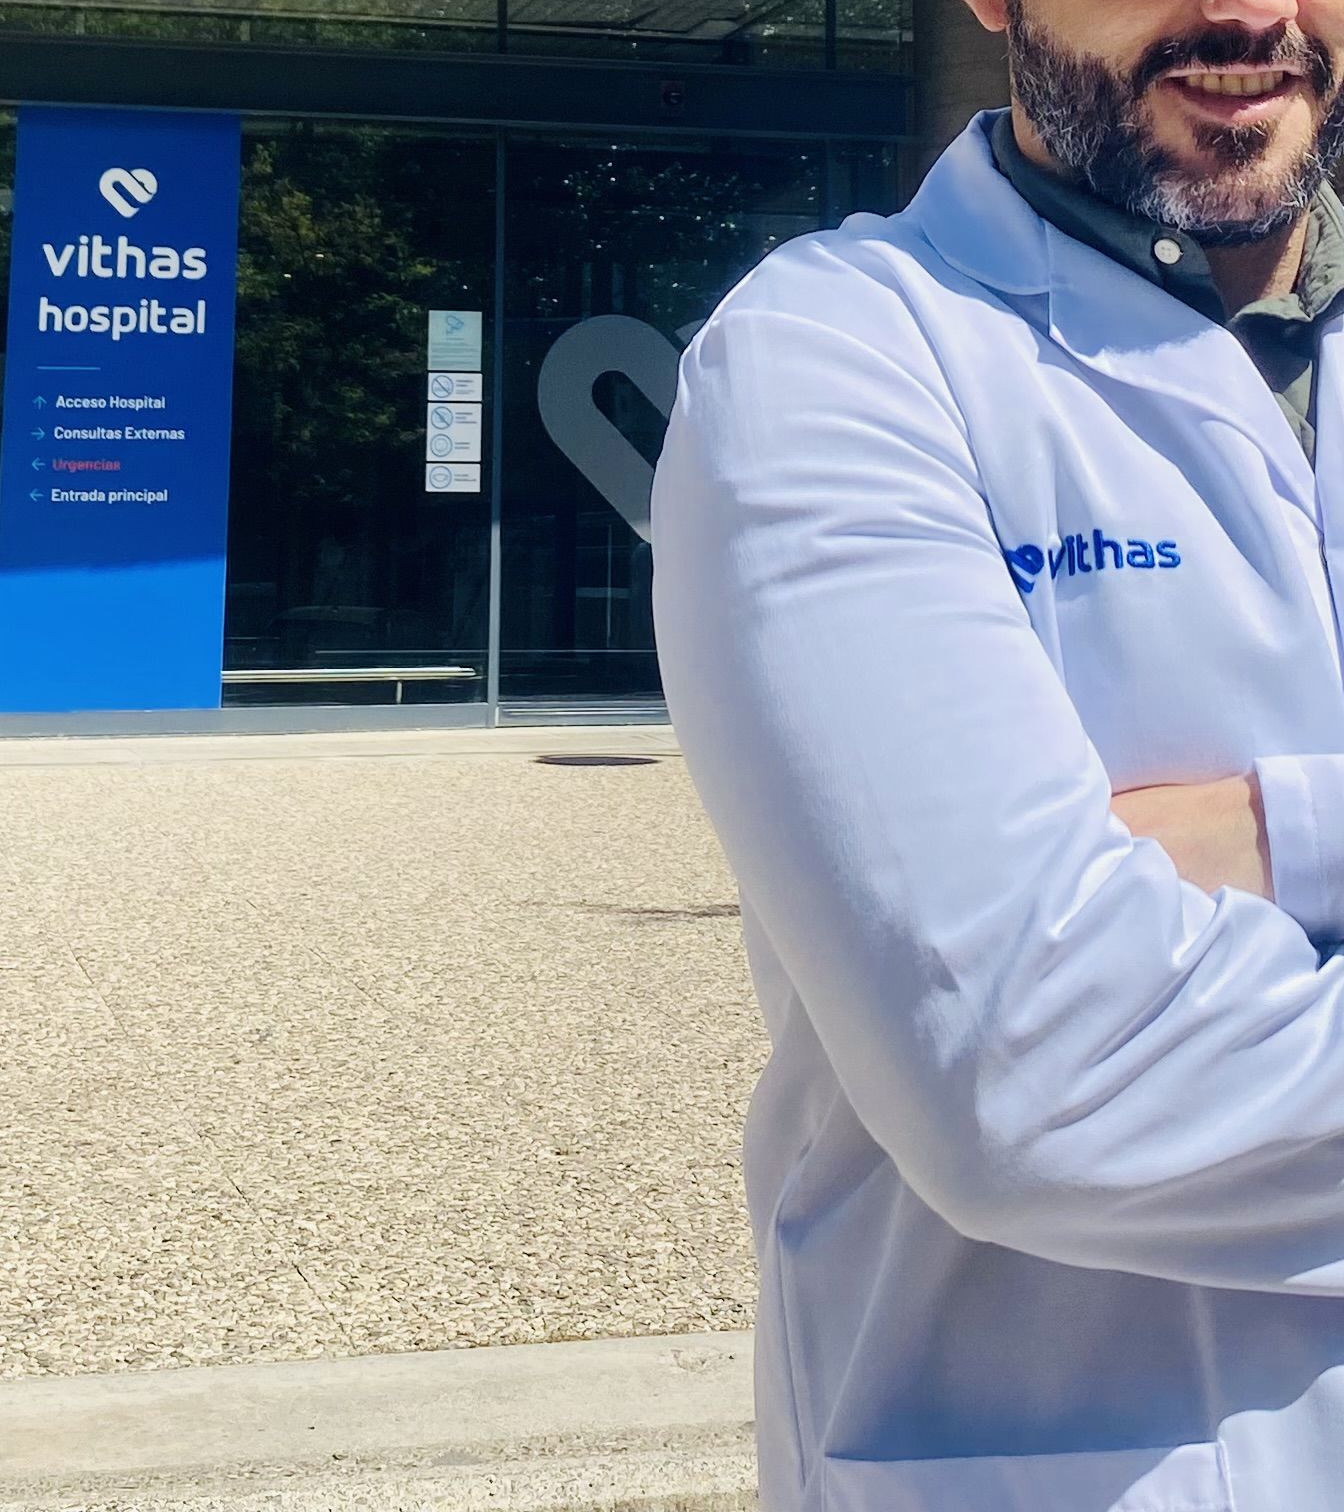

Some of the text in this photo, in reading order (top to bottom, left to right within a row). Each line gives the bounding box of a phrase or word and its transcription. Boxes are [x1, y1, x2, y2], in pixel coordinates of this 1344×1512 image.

[42, 234, 207, 280] vithas
[37, 296, 206, 341] hospital
[56, 395, 166, 411] Acceso Hospital
[54, 426, 185, 440] Consultas Externas
[52, 458, 121, 473] Urgencias
[51, 488, 168, 504] Entrada principal
[1047, 528, 1182, 580] vithas
